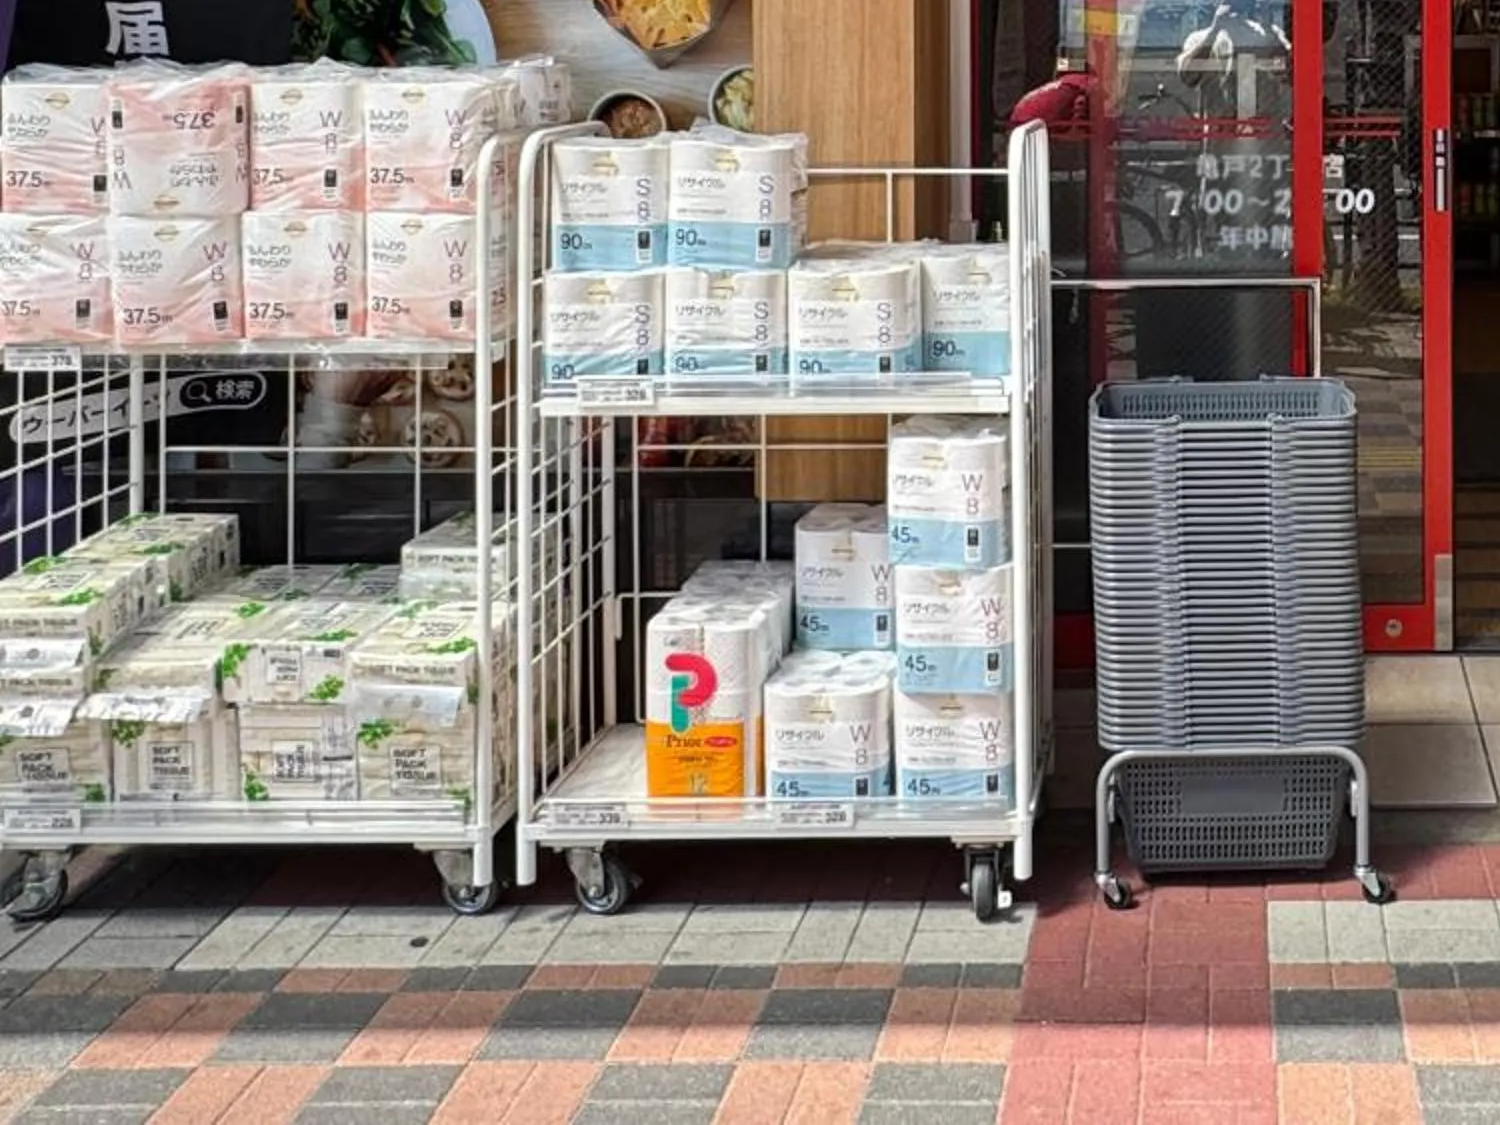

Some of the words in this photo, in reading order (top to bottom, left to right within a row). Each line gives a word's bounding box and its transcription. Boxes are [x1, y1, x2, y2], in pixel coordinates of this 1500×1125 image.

[320, 110, 343, 127] W
[446, 110, 467, 125] W
[112, 174, 132, 190] W
[636, 178, 651, 197] S
[758, 175, 775, 194] S
[637, 200, 650, 219] 8
[70, 241, 95, 261] W
[204, 242, 228, 261] W
[328, 241, 350, 260] W
[444, 240, 467, 257] W
[635, 304, 650, 324] S
[754, 301, 769, 320] S
[877, 301, 892, 321] S
[636, 329, 649, 346] 8
[754, 324, 769, 342] 8
[878, 326, 891, 344] 8
[962, 474, 983, 492] W
[967, 497, 979, 515] 8
[871, 564, 889, 582] W
[875, 586, 888, 604] 8
[981, 598, 1002, 617] W
[985, 621, 999, 641] 8
[849, 724, 871, 743] W
[979, 721, 1002, 739] W
[855, 748, 868, 766] 8
[985, 744, 998, 762] 8
